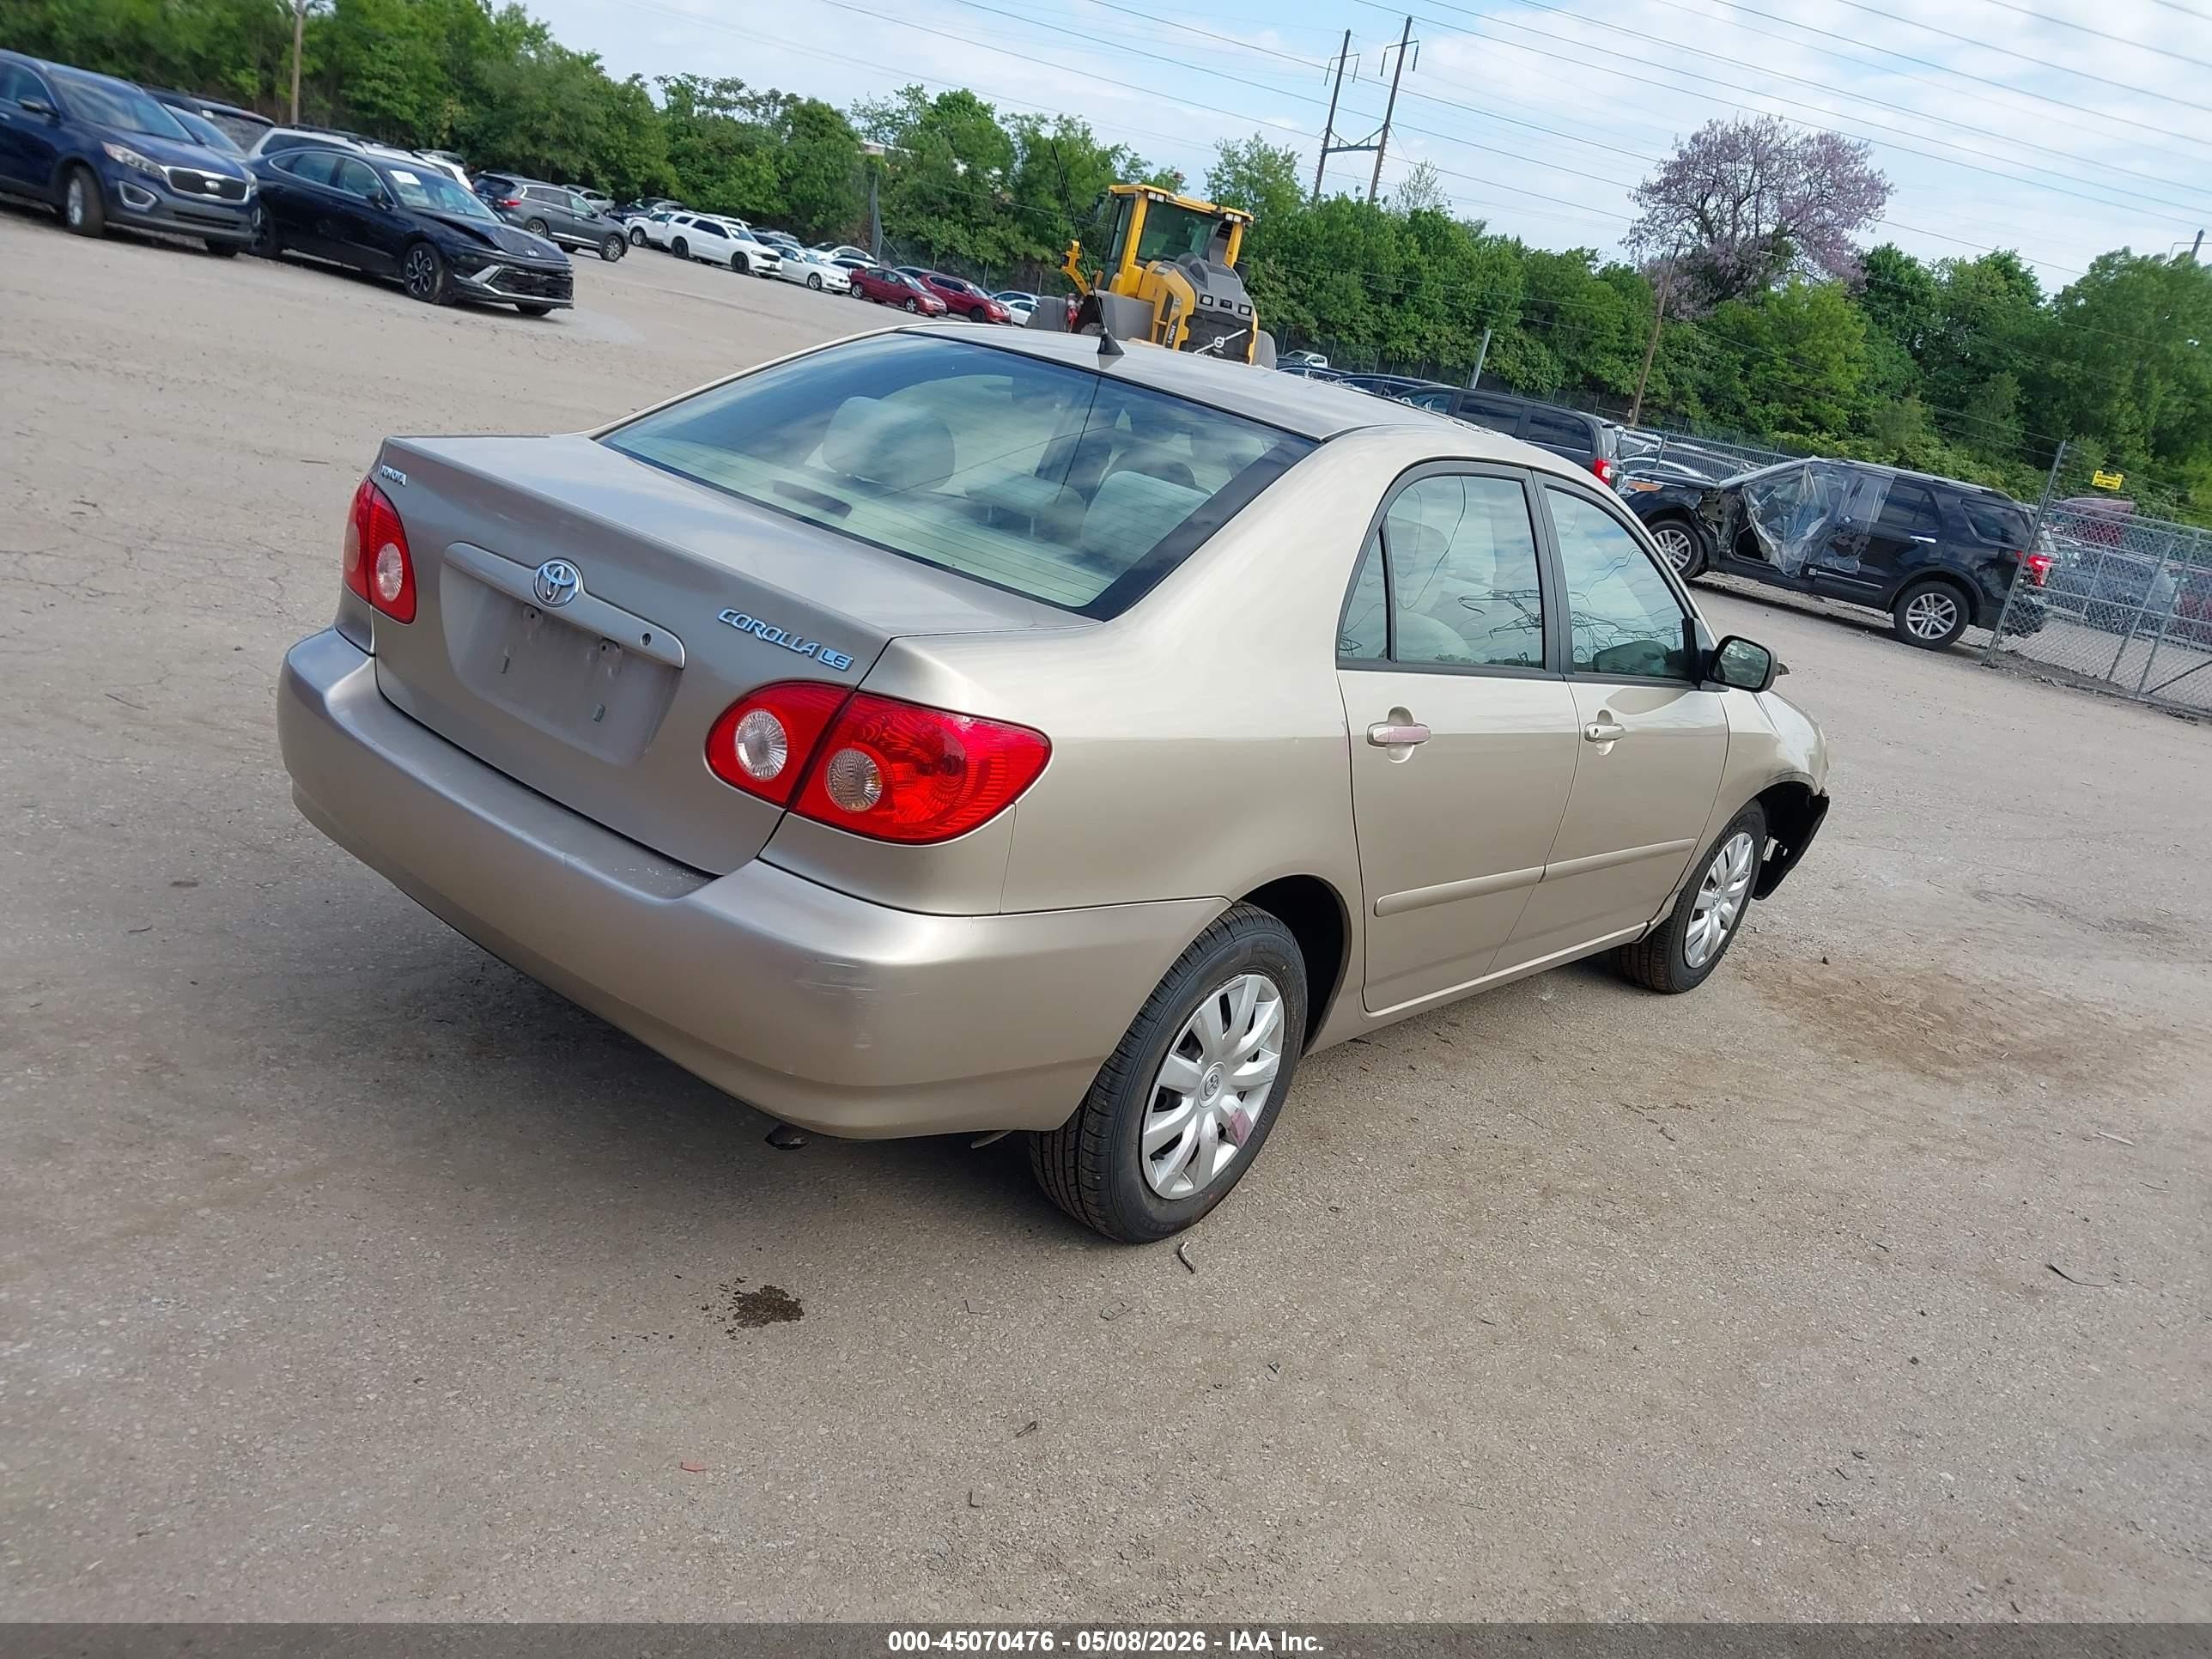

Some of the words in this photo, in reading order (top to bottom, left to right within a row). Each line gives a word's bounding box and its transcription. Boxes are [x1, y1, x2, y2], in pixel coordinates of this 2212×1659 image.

[381, 465, 407, 486] TOYOTA
[717, 608, 821, 659] COROLLA
[820, 648, 849, 670] LE
